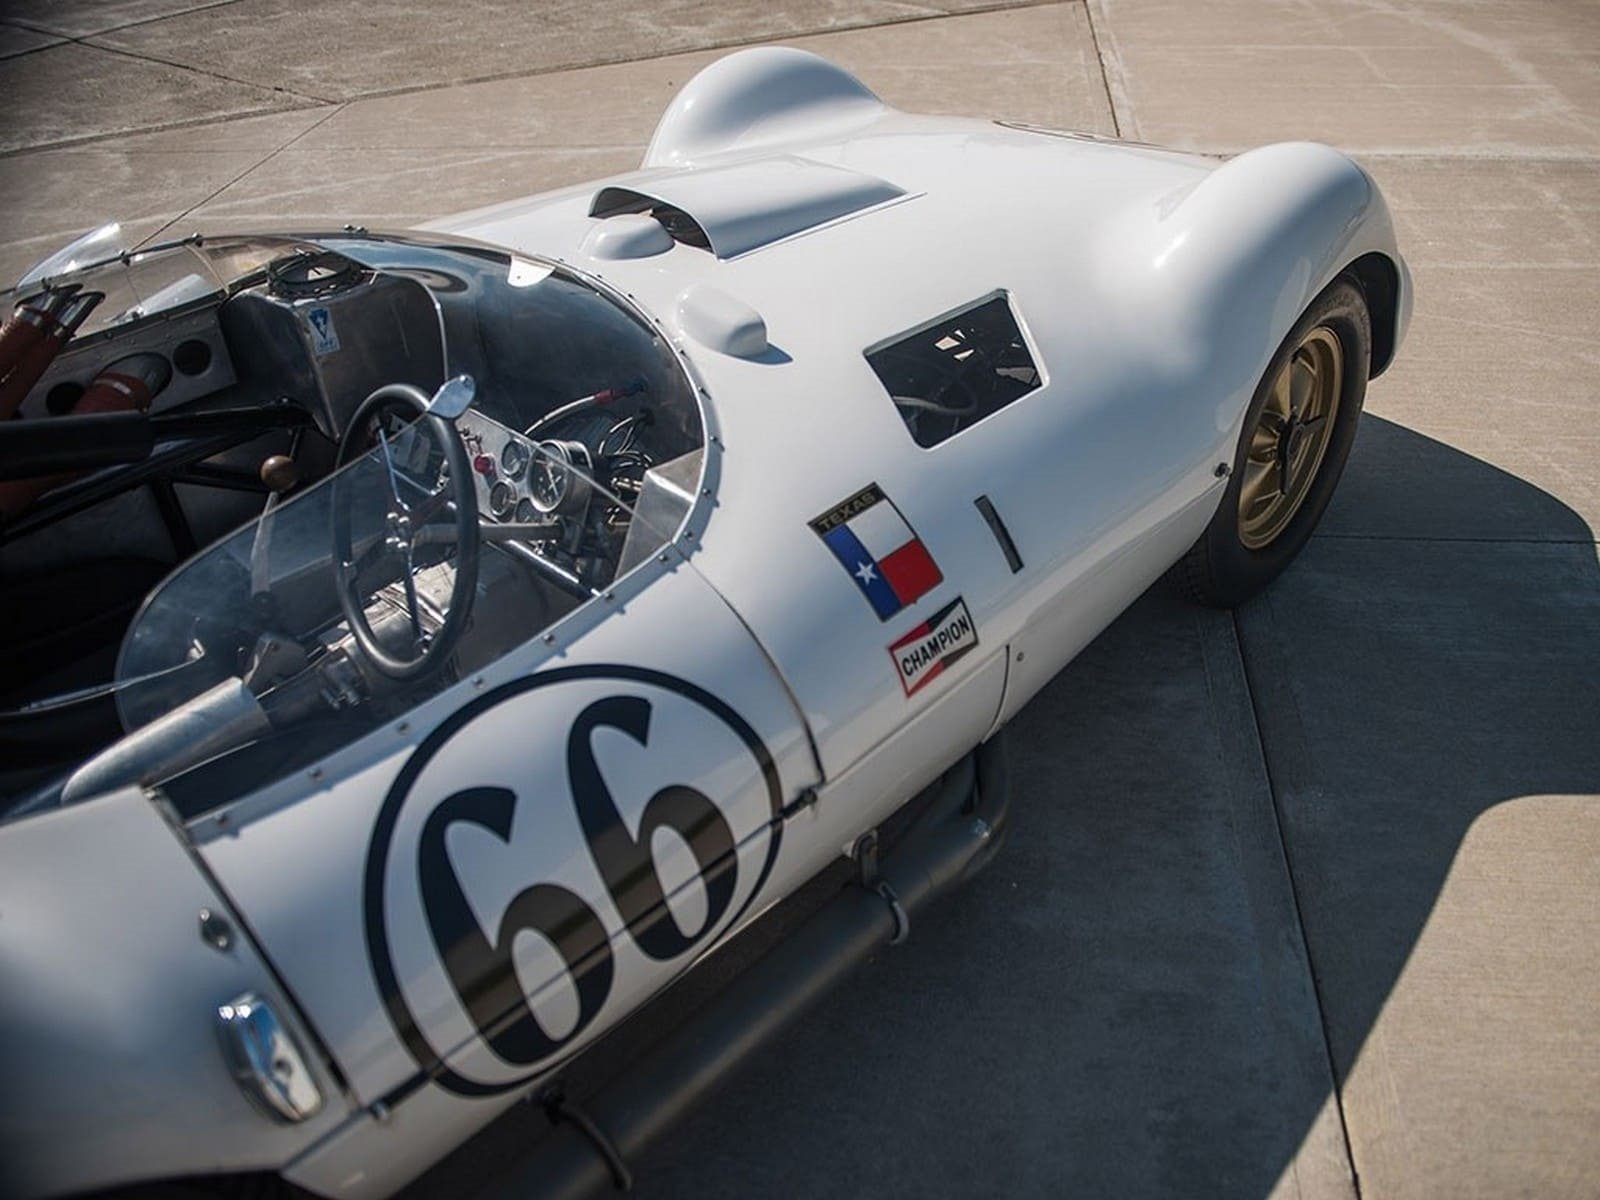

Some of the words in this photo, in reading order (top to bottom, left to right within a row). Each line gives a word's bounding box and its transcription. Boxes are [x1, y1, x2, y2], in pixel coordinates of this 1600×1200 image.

[818, 491, 876, 530] TEXAS
[901, 615, 970, 677] CHAMPION
[418, 695, 739, 1067] 66
